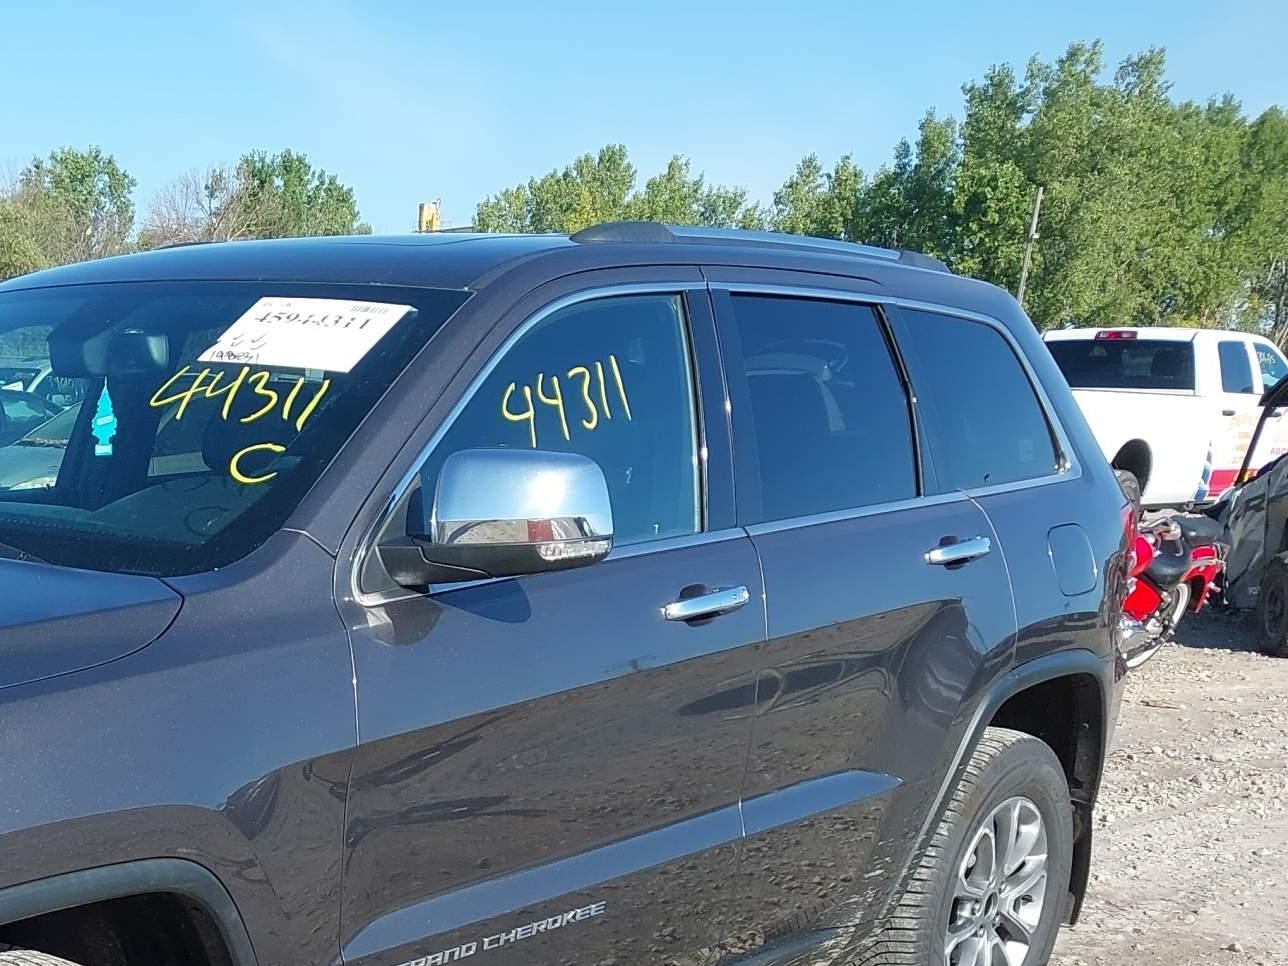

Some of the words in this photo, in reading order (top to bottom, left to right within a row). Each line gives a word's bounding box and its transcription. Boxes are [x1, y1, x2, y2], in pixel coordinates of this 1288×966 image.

[150, 365, 331, 433] 44311
[502, 354, 632, 448] 44311
[230, 443, 286, 484] C
[483, 900, 607, 952] CHEROKEE
